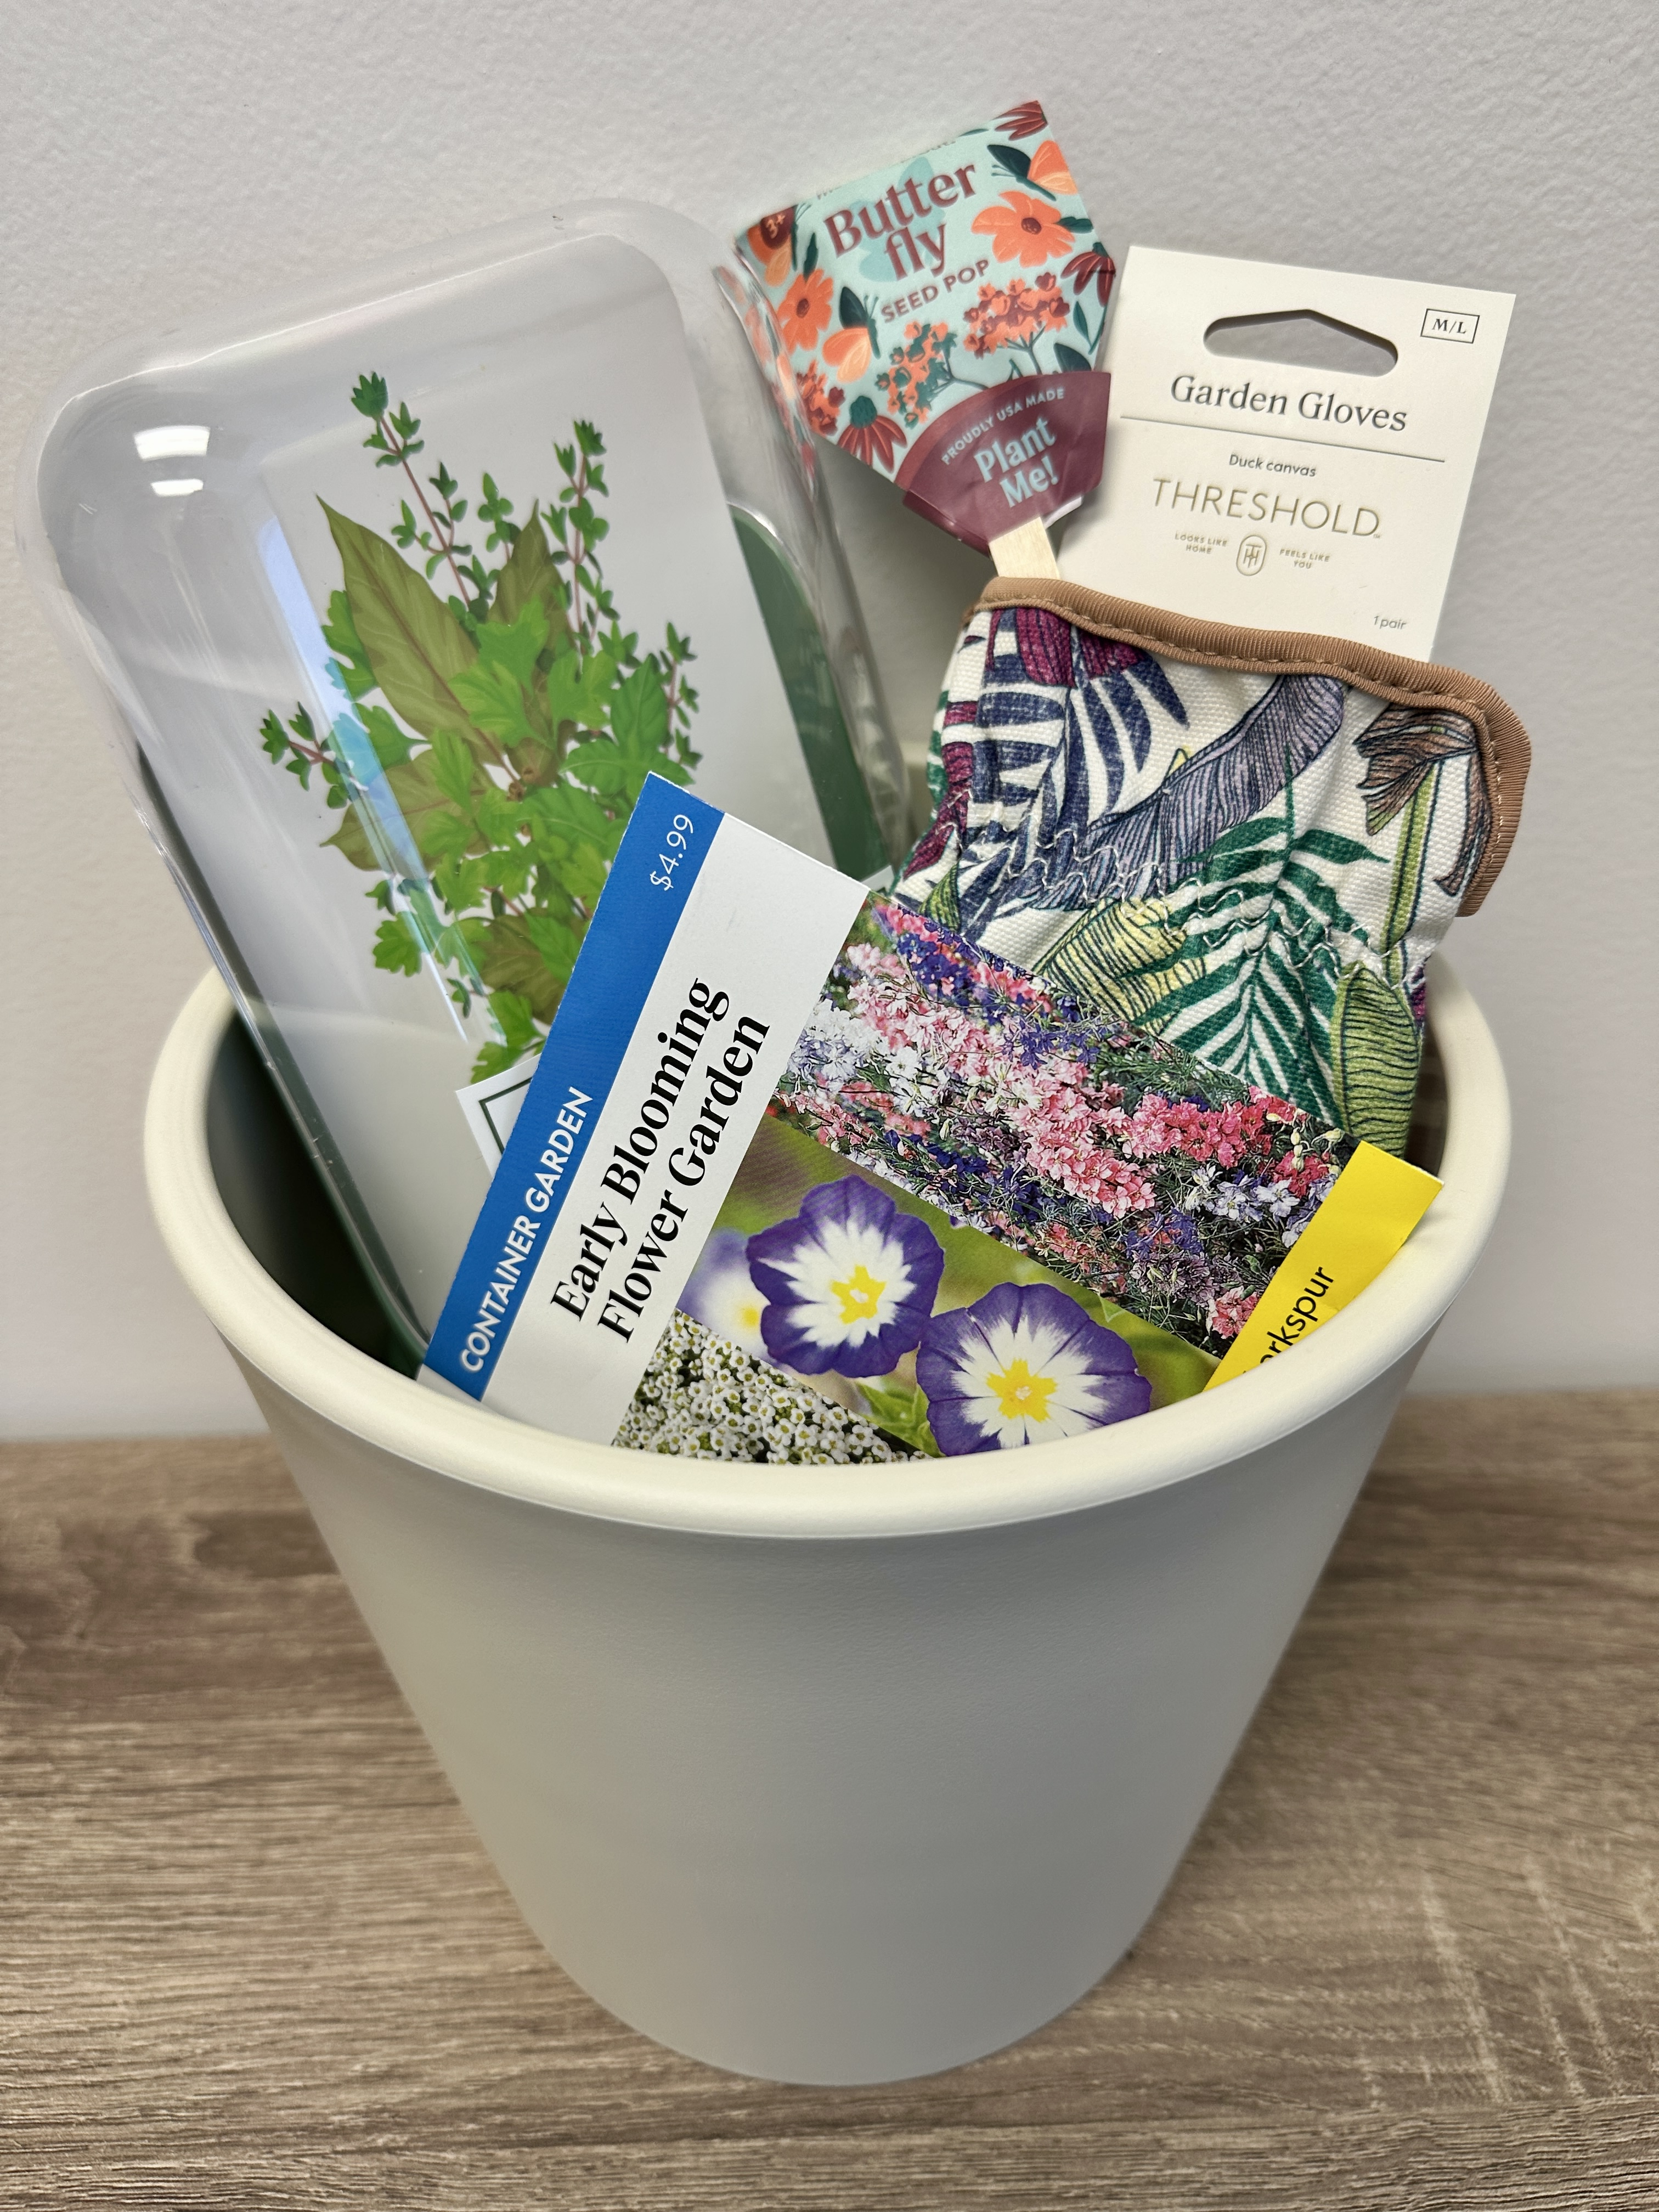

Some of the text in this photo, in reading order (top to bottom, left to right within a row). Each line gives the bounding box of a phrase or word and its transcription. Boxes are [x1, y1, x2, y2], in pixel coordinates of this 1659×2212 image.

[823, 164, 976, 257] Butter
[883, 221, 948, 280] fly
[882, 259, 991, 323] SEED POP
[1432, 318, 1468, 335] M/L
[941, 388, 1064, 465] PROUDLY USA MADE
[1170, 375, 1408, 432] Garden Gloves
[973, 417, 1056, 483] Plant
[1229, 454, 1317, 477] Duck canvas
[999, 456, 1059, 507] Me!
[1174, 533, 1228, 548] LOOKS LIKE
[1186, 544, 1212, 555] HOME
[1279, 549, 1330, 563] FEELS LIKE
[1293, 560, 1312, 569] YOU
[1379, 618, 1407, 630] pair
[650, 814, 694, 891] $4.99
[550, 977, 730, 1321] Early Blooming
[597, 1014, 770, 1343] Flower Garden
[460, 1086, 594, 1373] CONTAINER GARDEN
[1243, 1266, 1334, 1374] rkspur
